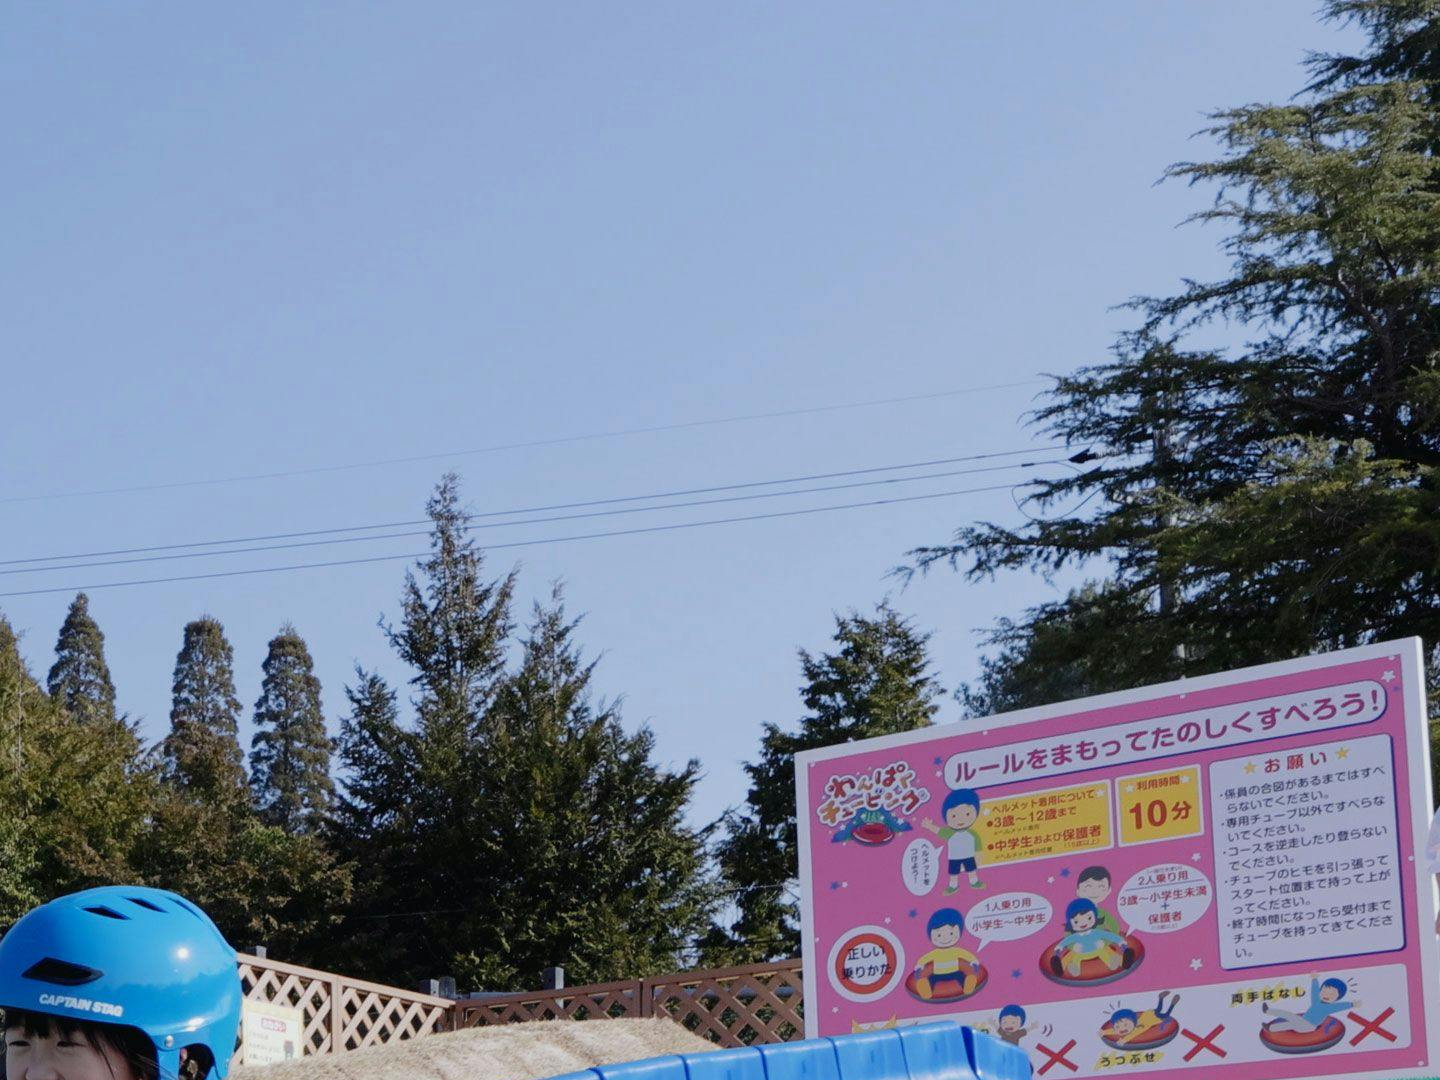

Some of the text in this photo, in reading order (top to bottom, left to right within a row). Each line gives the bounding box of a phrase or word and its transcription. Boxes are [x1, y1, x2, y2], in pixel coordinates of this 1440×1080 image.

[1264, 751, 1327, 774] お願い
[1136, 775, 1181, 791] 利用時間
[1129, 799, 1192, 830] 10分
[1138, 870, 1188, 886] 2人乗り用
[1148, 911, 1182, 924] 保護者
[848, 945, 885, 961] 正しい
[842, 963, 892, 980] 乗りかた
[39, 994, 123, 1017] CAPTAIN STAG
[1100, 1052, 1155, 1067] うつぶせ
